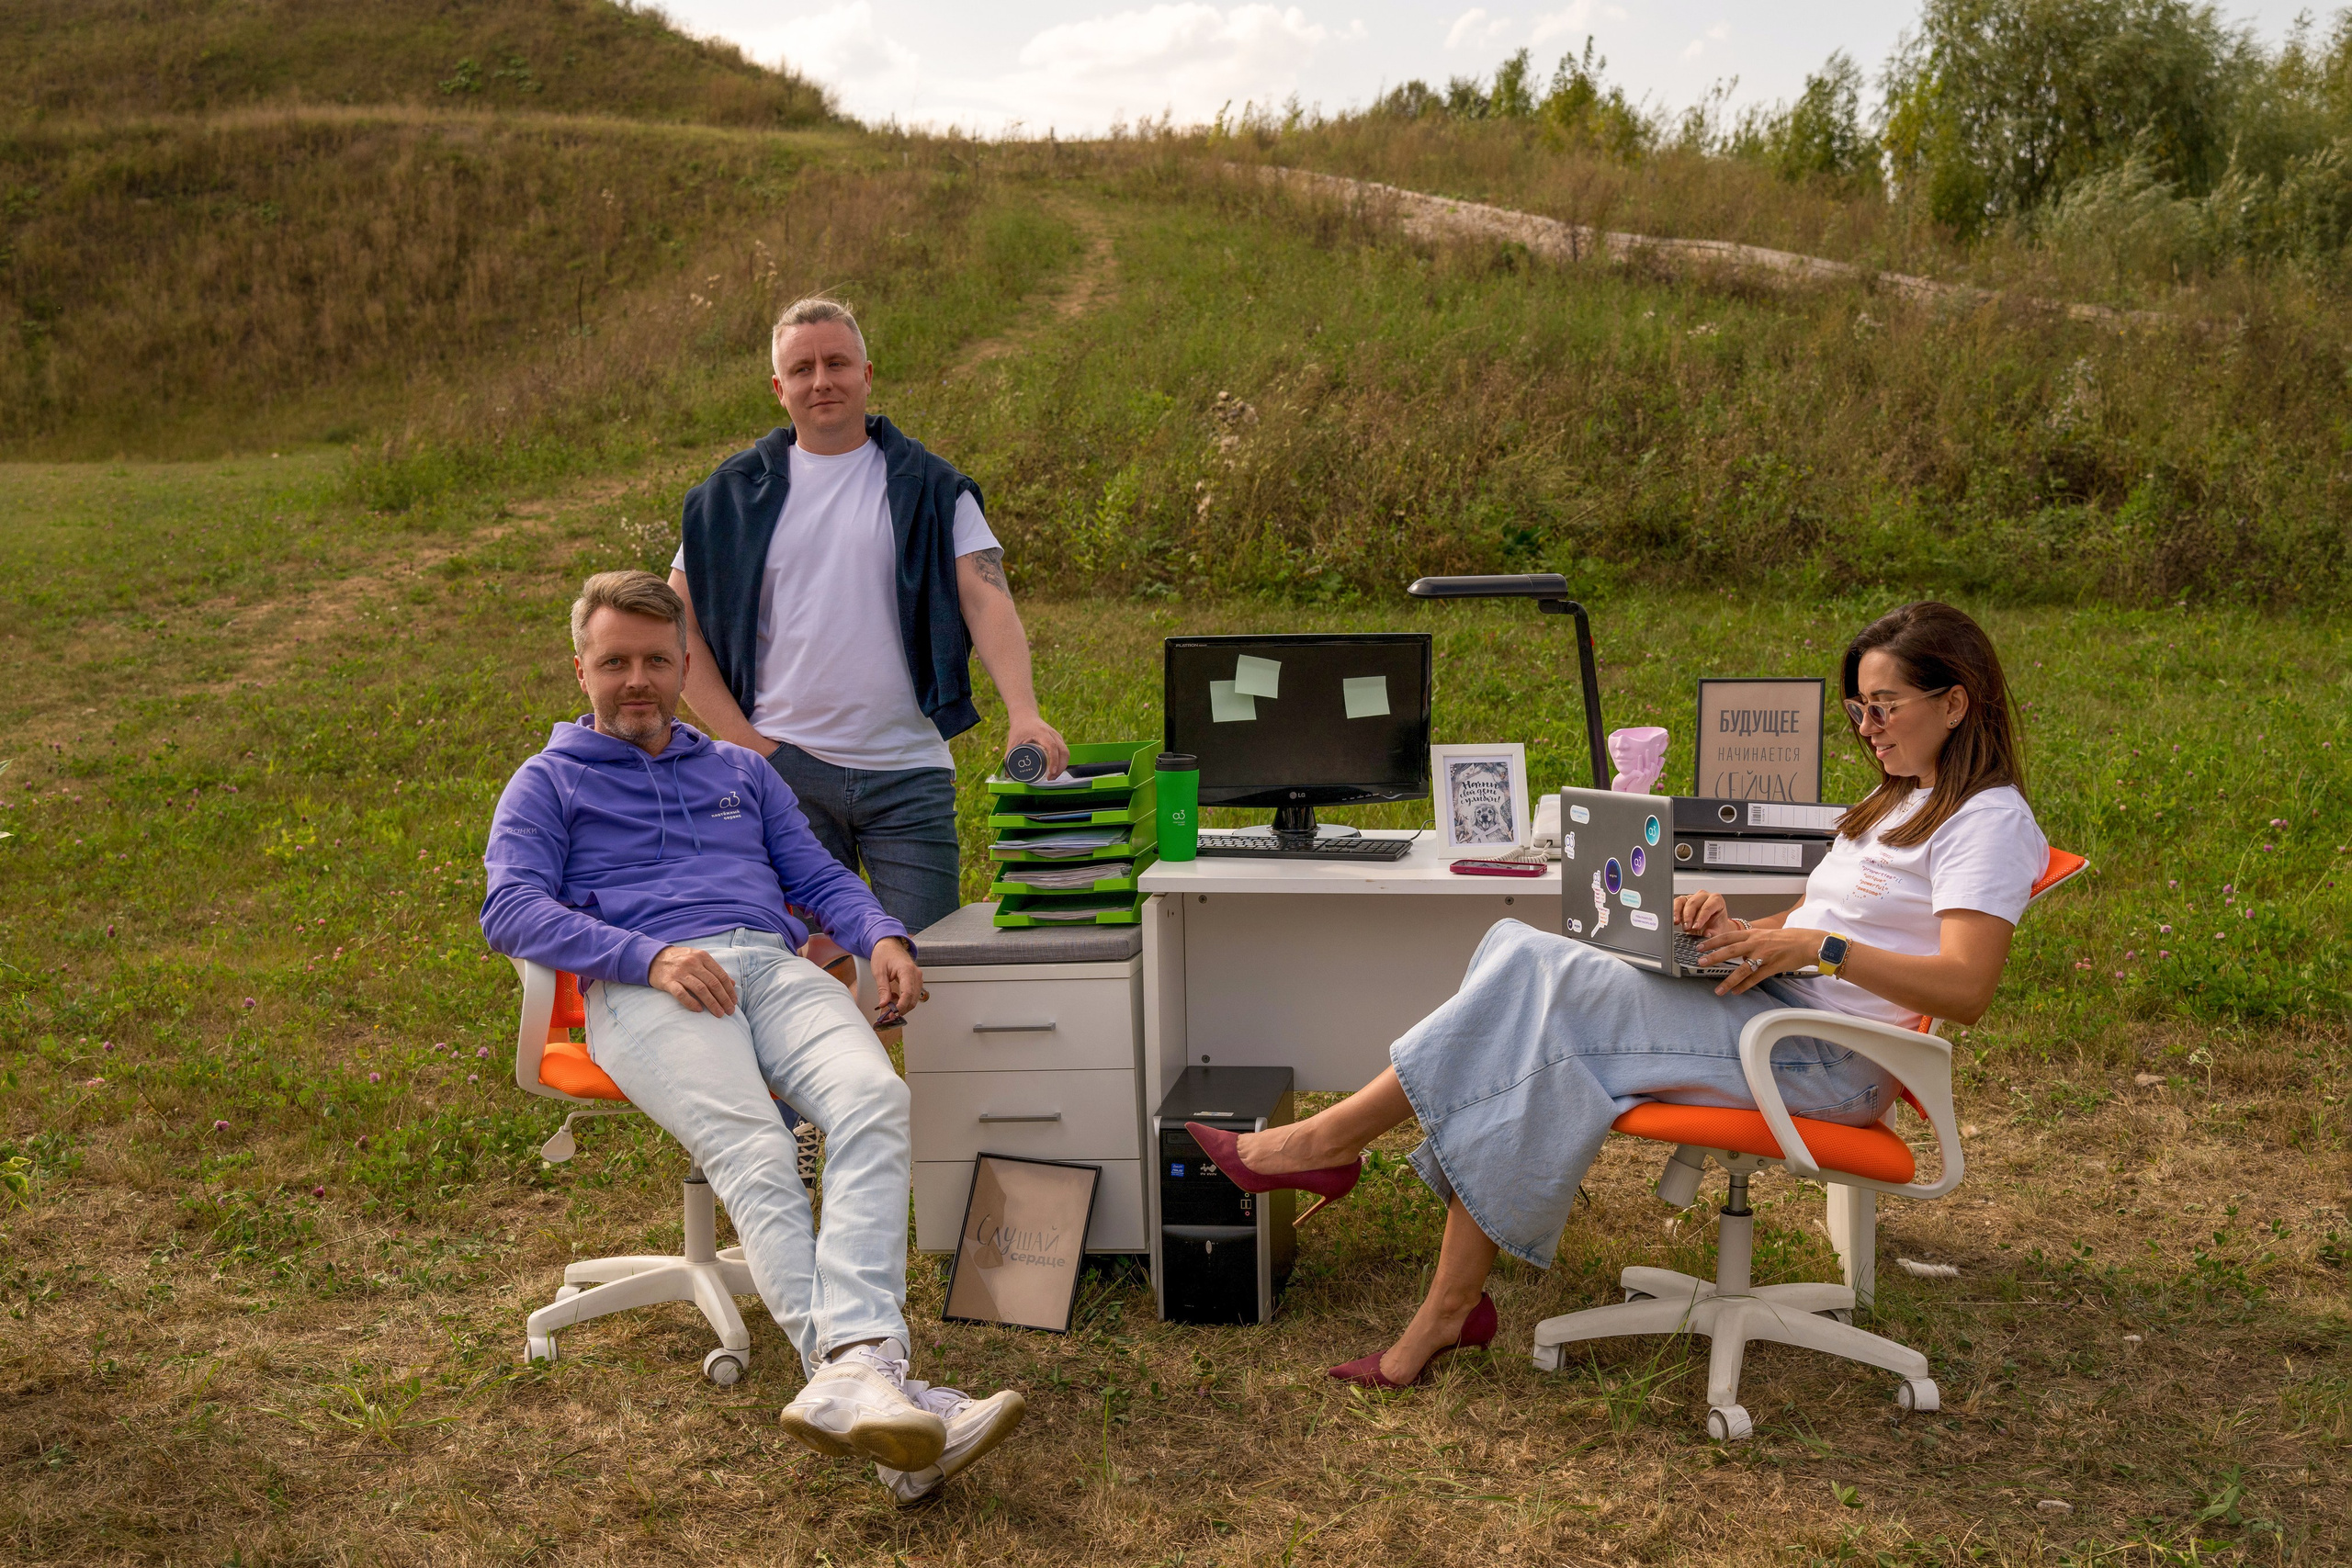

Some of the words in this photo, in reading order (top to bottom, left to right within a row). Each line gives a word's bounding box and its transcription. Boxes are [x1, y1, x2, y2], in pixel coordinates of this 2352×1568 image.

[1720, 710, 1800, 737] БУДУЩЕЕ
[1718, 747, 1800, 761] НАЧИНАЕТСЯ
[1714, 770, 1798, 802] СЕЙЧАС
[1011, 1252, 1066, 1268] сердце
